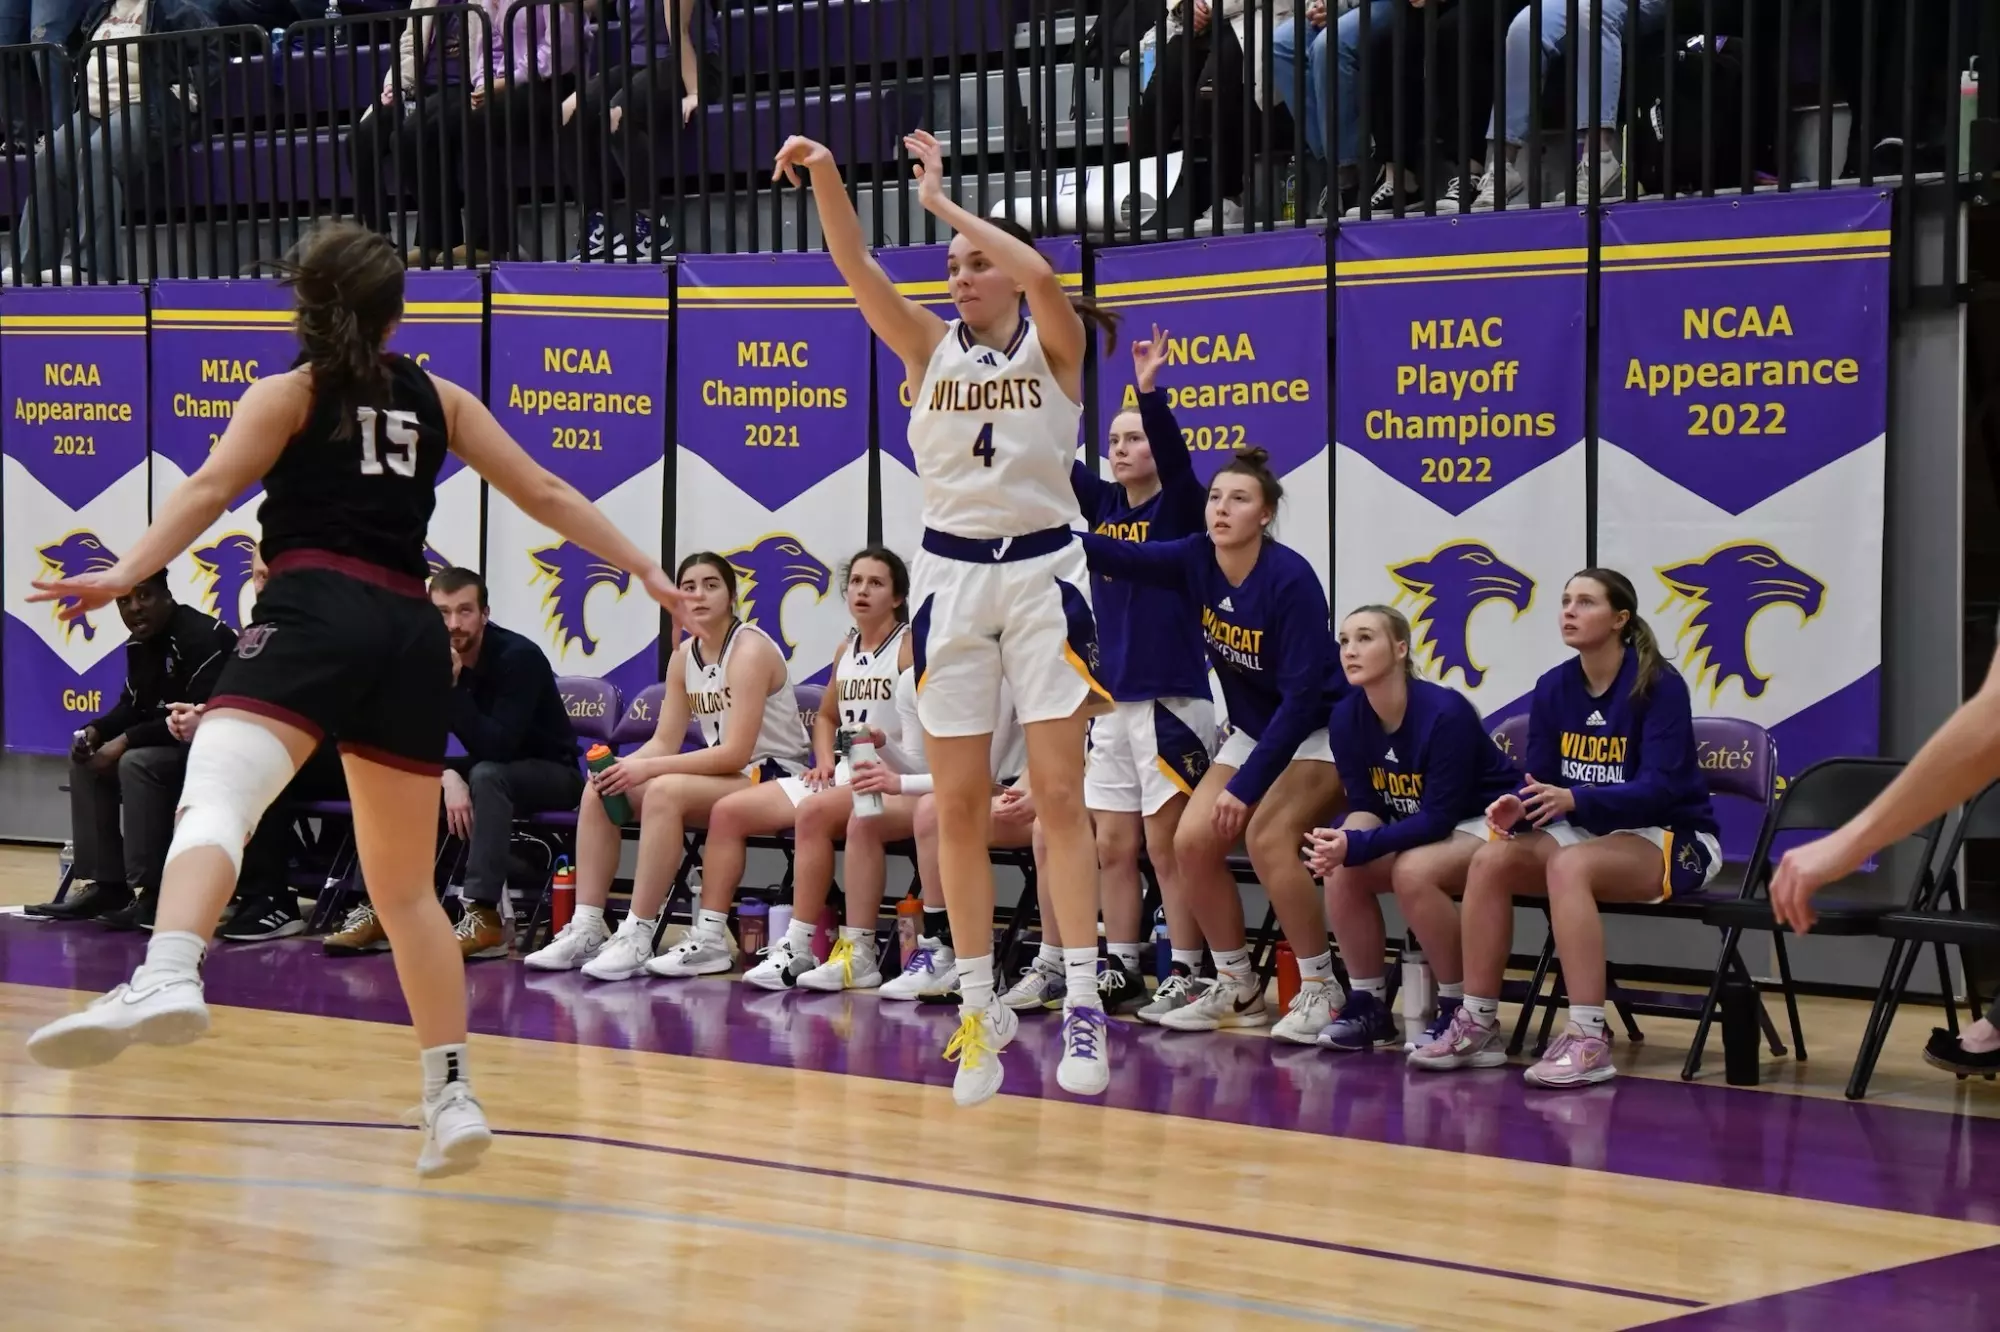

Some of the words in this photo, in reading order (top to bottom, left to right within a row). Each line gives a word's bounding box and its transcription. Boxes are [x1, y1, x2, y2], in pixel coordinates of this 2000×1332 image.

[1411, 317, 1503, 349] MIAC
[1683, 305, 1793, 339] NCAA
[544, 348, 612, 375] NCAA
[737, 342, 808, 368] MIAC
[1166, 333, 1256, 366] NCAA
[45, 363, 101, 387] NCAA
[202, 359, 260, 384] MIAC
[1397, 360, 1518, 400] Playoff
[1624, 357, 1859, 396] Appearance
[509, 384, 652, 415] Appearance
[703, 380, 848, 412] Champions
[15, 399, 132, 423] Appearance
[1688, 403, 1787, 436] 2022
[552, 428, 603, 451] 2021
[746, 424, 800, 448] 2021
[1181, 425, 1247, 451] 2022
[1365, 407, 1556, 445] Champions
[53, 435, 96, 456] 2021
[357, 406, 421, 478] 15
[973, 422, 996, 468] 4
[1421, 457, 1492, 484] 2022
[62, 690, 102, 714] Golf
[837, 677, 892, 701] ILDCATS
[629, 698, 652, 721] St.
